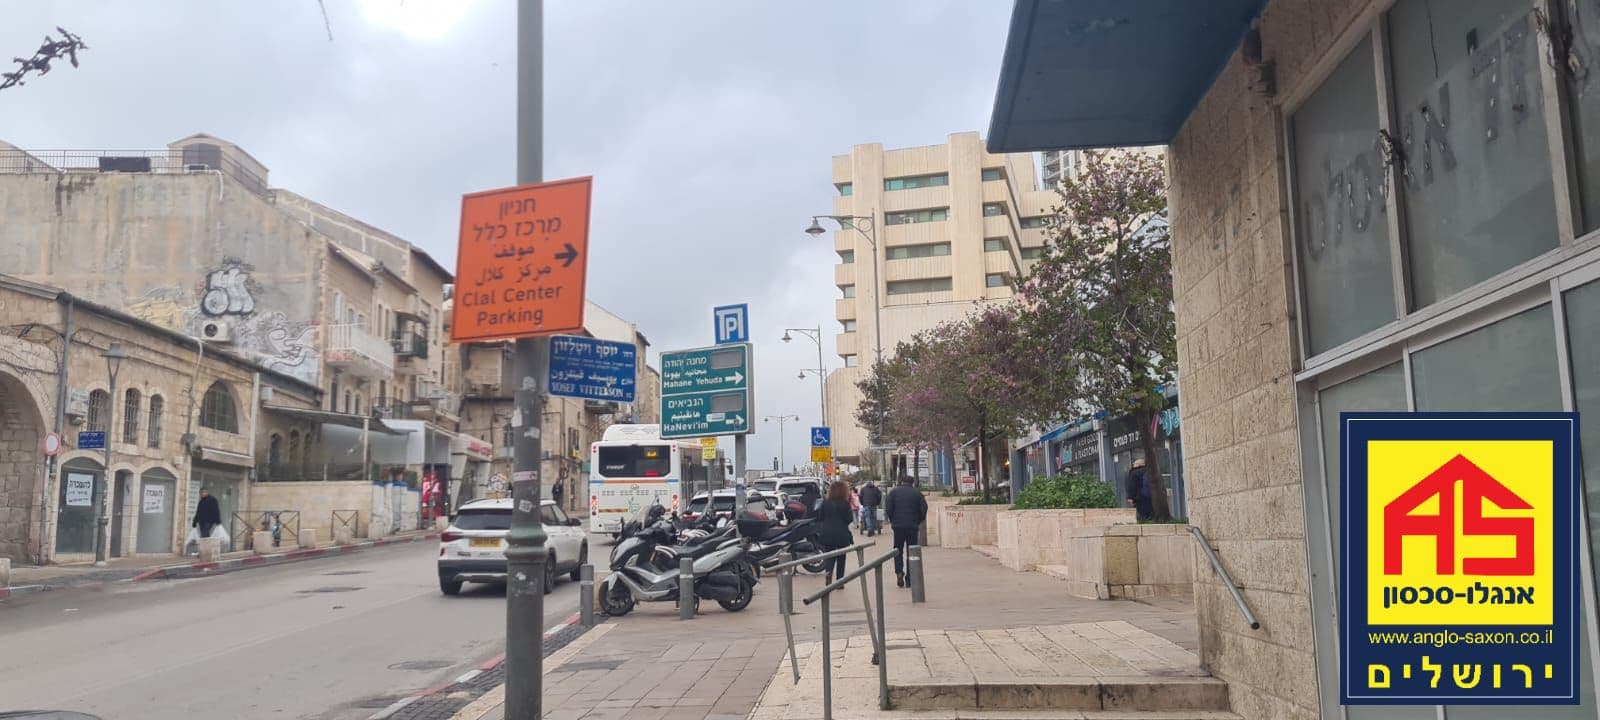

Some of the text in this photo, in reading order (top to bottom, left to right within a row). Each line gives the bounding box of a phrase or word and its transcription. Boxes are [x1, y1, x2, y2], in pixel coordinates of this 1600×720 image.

[499, 198, 536, 220] חניון
[473, 217, 562, 242] מרכז כלל
[495, 242, 535, 261] موقف
[476, 263, 552, 287] مركز كلال
[462, 285, 563, 307] Clal Center
[477, 307, 544, 326] Parking
[664, 356, 707, 368] מחנה יהודה
[663, 376, 723, 388] Mahane Yehuda
[668, 398, 704, 408] הנביאים
[663, 422, 708, 432] HaNevi'im
